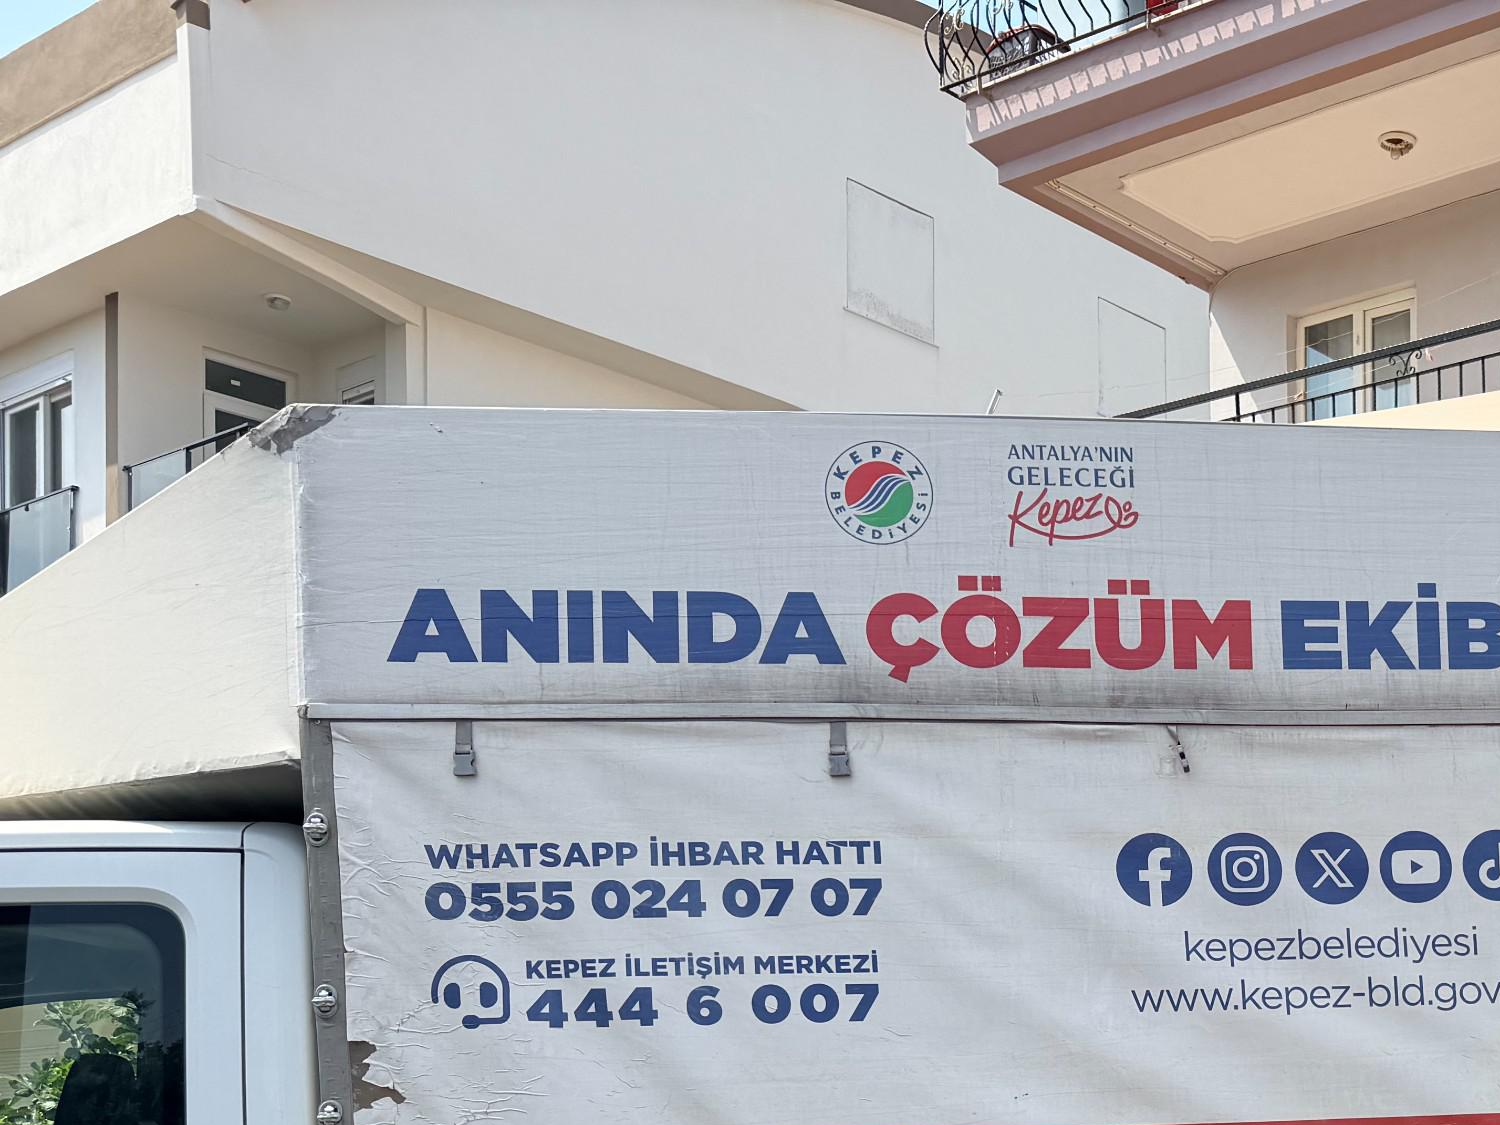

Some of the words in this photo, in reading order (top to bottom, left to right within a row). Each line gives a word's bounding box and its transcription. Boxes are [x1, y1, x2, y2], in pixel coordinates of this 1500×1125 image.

[833, 445, 924, 481] KEPEZ
[1007, 465, 1135, 488] GELECEĞİ
[1008, 487, 1110, 547] Kepez
[386, 588, 848, 665] ANINDA
[866, 575, 1254, 684] ÇÖZÜM
[424, 840, 639, 871] WHATSAPP
[649, 834, 765, 867] İHBAR
[775, 839, 883, 866] HATTI
[424, 880, 576, 922] 0555
[591, 879, 708, 920] 024
[722, 878, 795, 918] 07
[809, 877, 884, 917] 07
[525, 958, 618, 980] KEPEZ
[625, 950, 746, 982] İLETİŞİM
[753, 948, 880, 976] MERKEZİ
[1183, 925, 1479, 968] kepezbelediyesi
[525, 986, 660, 1029] 444
[686, 985, 724, 1027] 6
[751, 983, 881, 1025] 007
